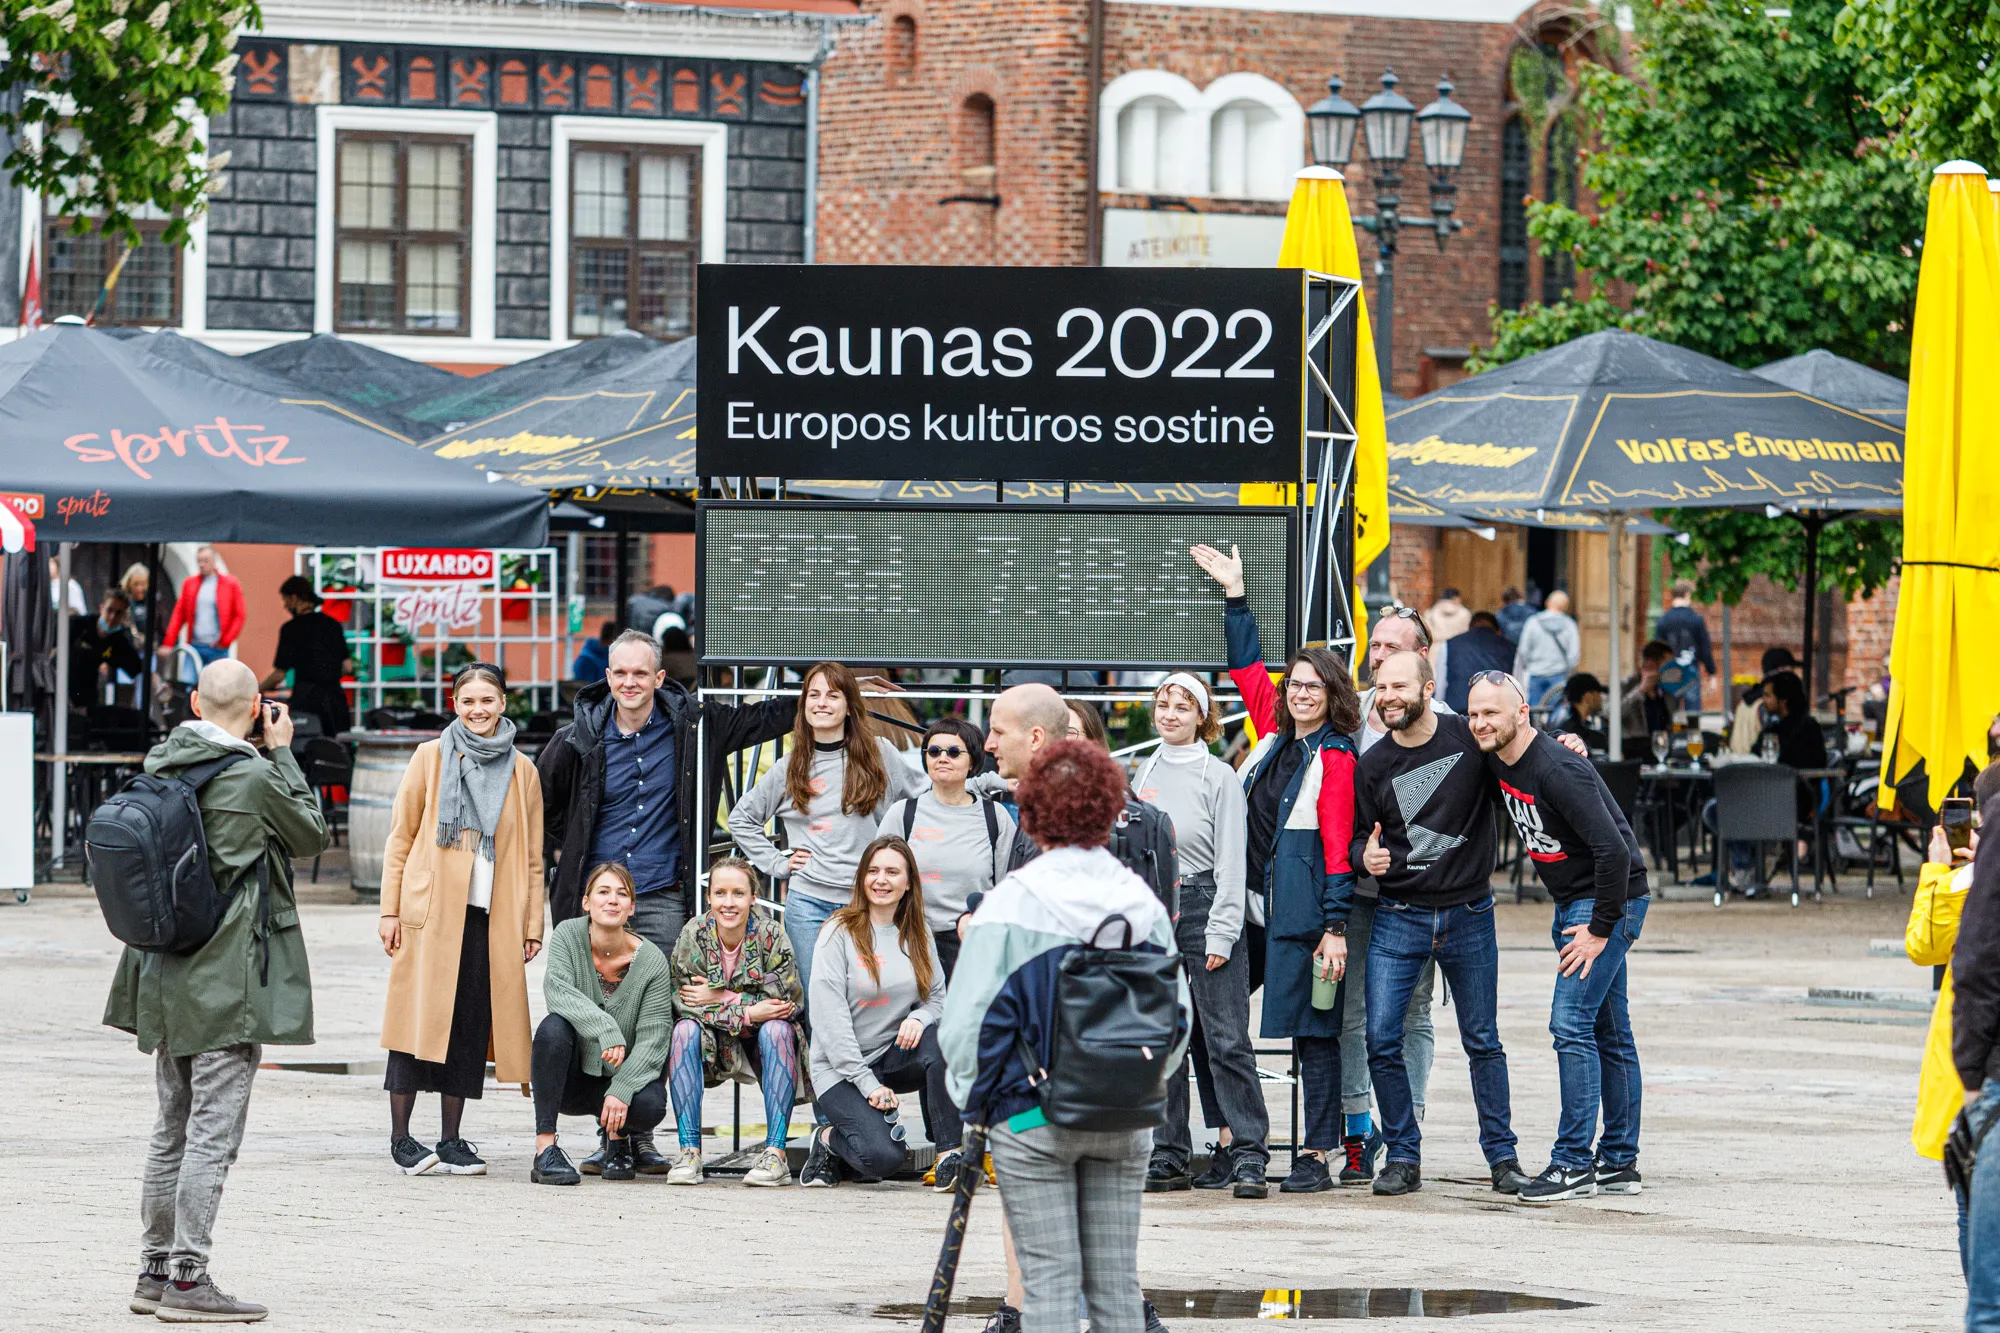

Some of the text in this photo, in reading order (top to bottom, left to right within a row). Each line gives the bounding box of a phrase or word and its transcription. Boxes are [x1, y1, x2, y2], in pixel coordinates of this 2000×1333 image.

[728, 306, 1274, 378] Kaunas 2022
[63, 416, 307, 480] spritz
[728, 402, 1274, 449] Europos kultūros sostinė
[56, 489, 112, 526] spritz
[385, 553, 490, 576] LUXARDO
[397, 583, 478, 635] spritz
